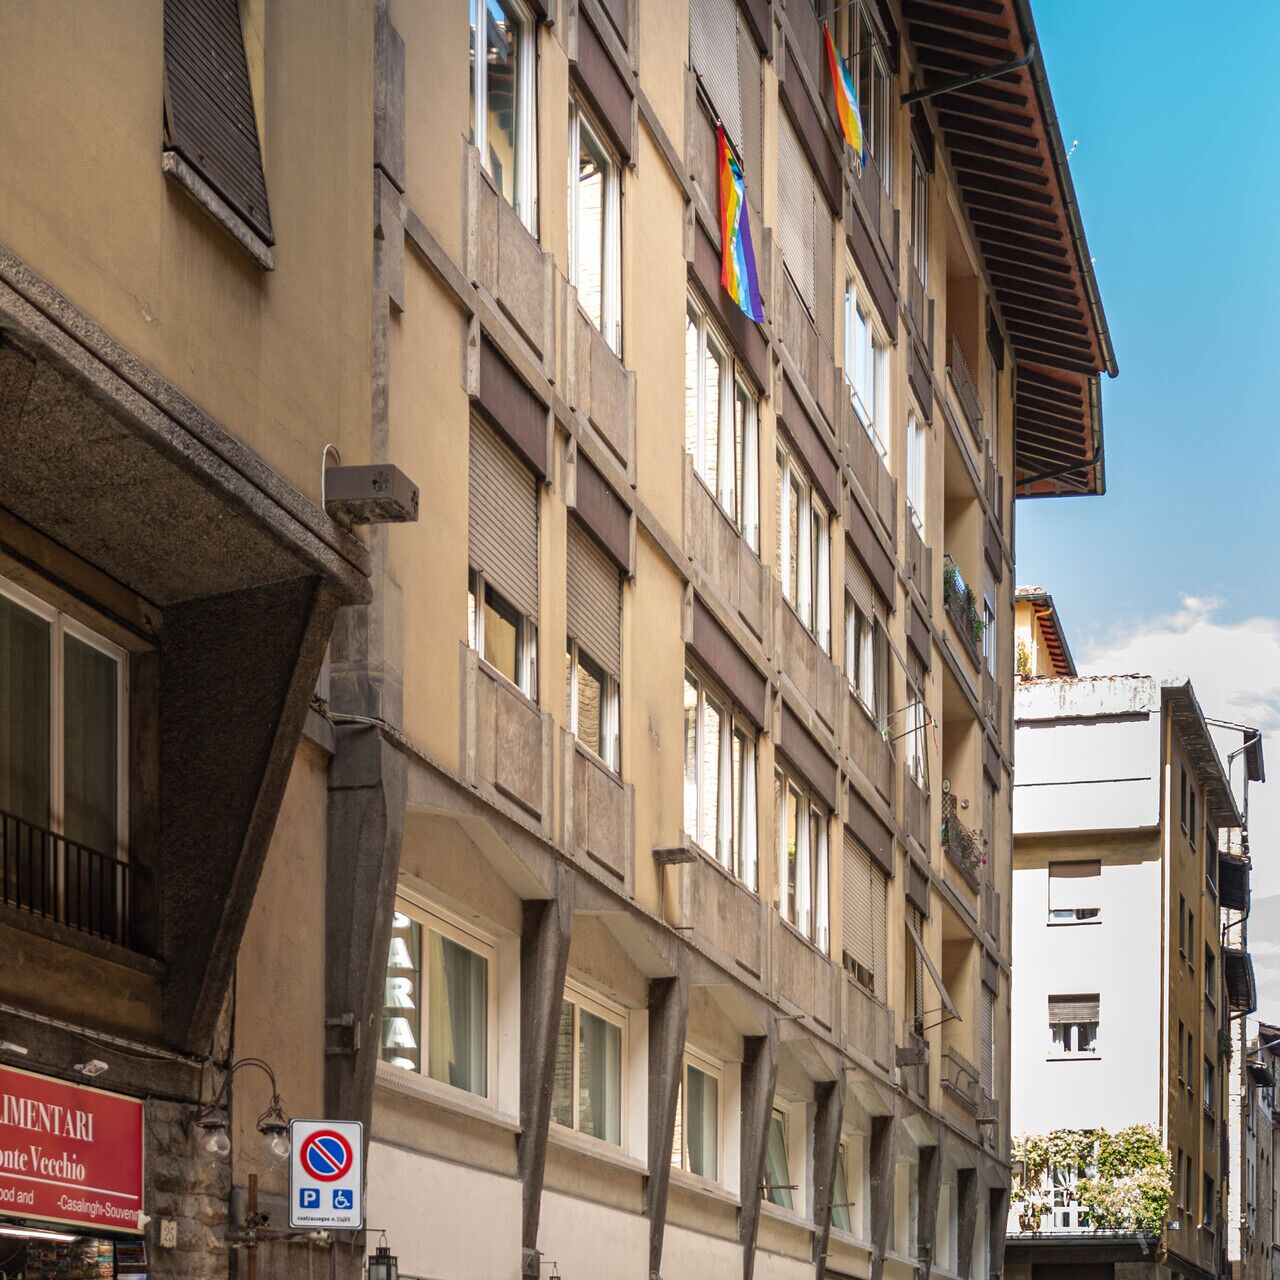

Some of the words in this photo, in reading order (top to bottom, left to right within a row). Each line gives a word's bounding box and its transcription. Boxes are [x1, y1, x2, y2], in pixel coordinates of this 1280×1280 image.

[29, 1145, 86, 1181] Vecchio
[17, 1189, 35, 1205] and
[304, 1190, 317, 1207] P
